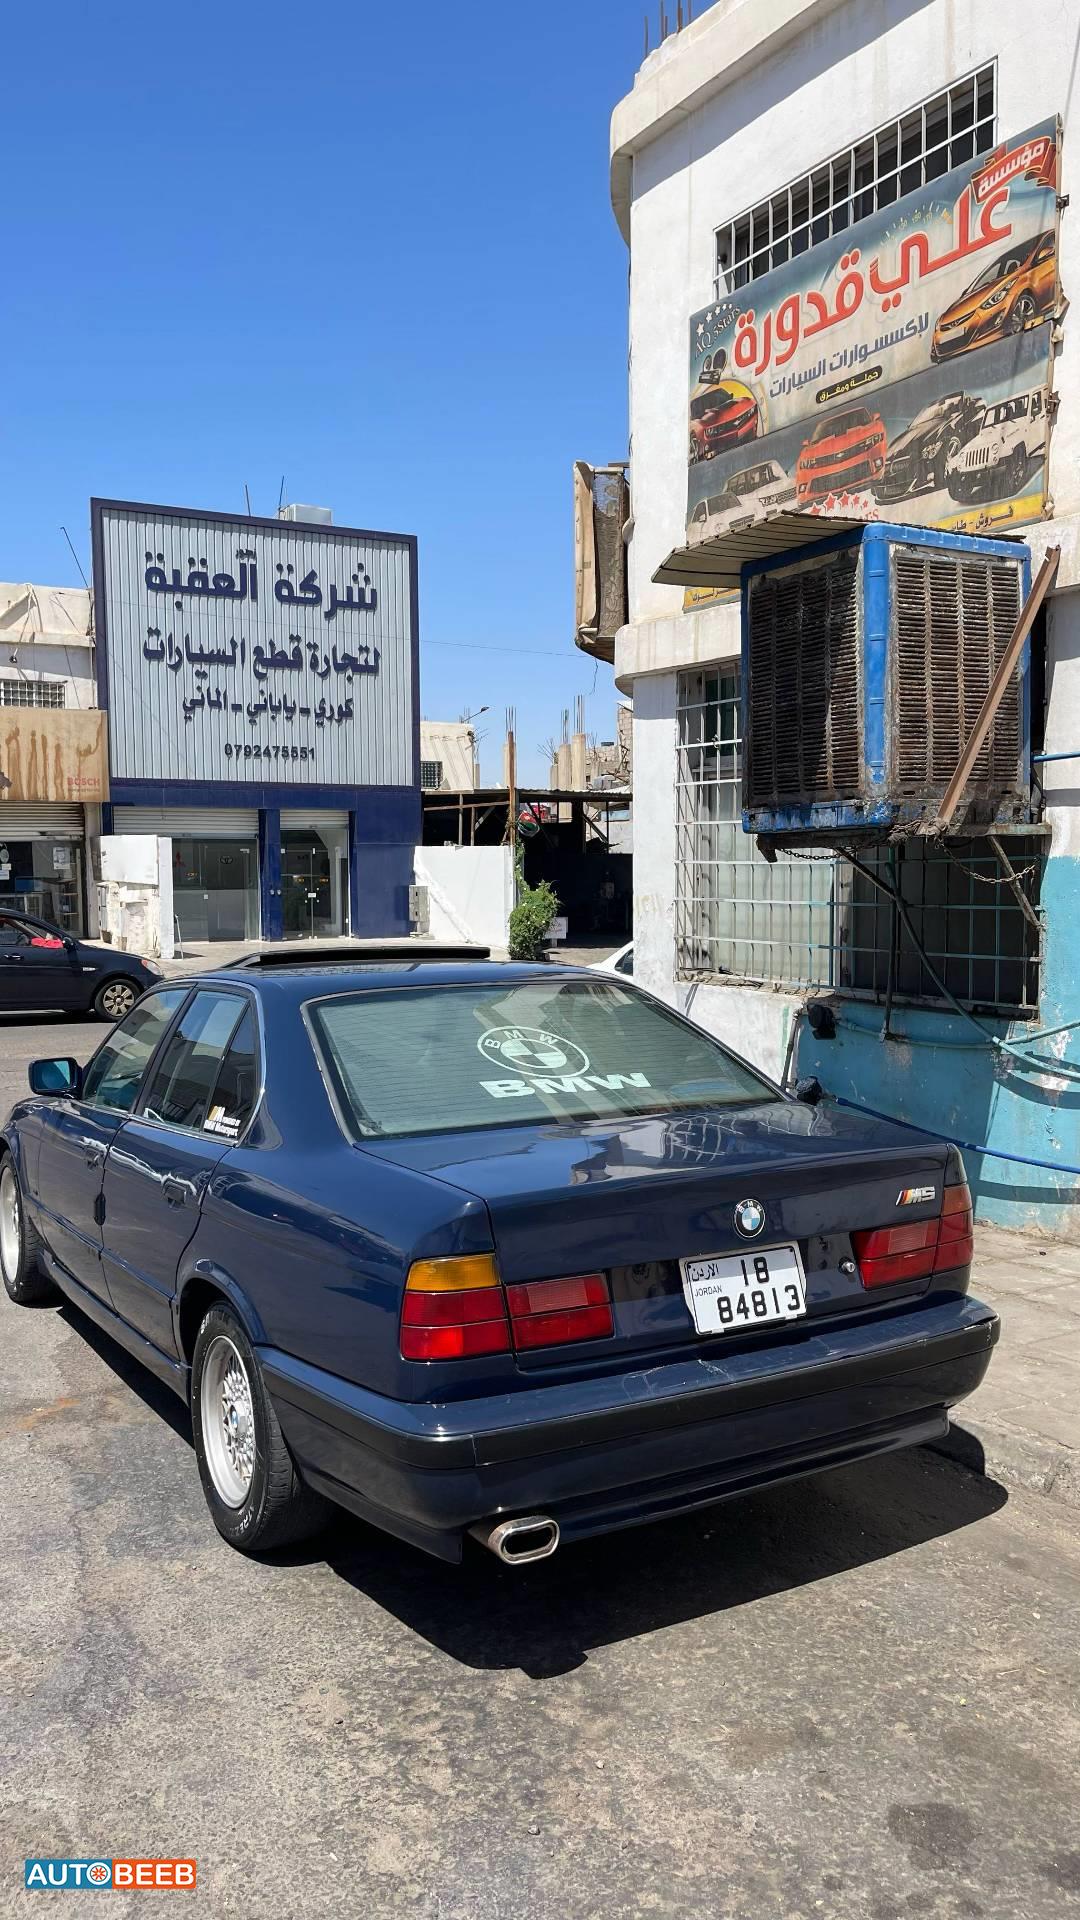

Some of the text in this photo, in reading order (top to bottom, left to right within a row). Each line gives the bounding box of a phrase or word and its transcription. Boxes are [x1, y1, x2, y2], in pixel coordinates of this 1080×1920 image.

[978, 142, 1045, 199] مؤسسة
[734, 185, 1012, 377] علي قدورة
[769, 312, 929, 398] لإكسسوارات السيارات
[819, 369, 879, 401] جملة ومفرق
[144, 551, 378, 621] شركة العقبة
[143, 626, 381, 684] لتجارة قطع السيارات
[183, 685, 228, 722] الماني
[247, 689, 297, 725] ياباني
[314, 697, 354, 728] كوري
[67, 776, 101, 786] BOSCH
[484, 1029, 559, 1050] BMW
[479, 1072, 651, 1098] BMW
[740, 1256, 770, 1286] 18
[694, 1284, 723, 1297] JORDAN
[717, 1284, 801, 1323] 84813
